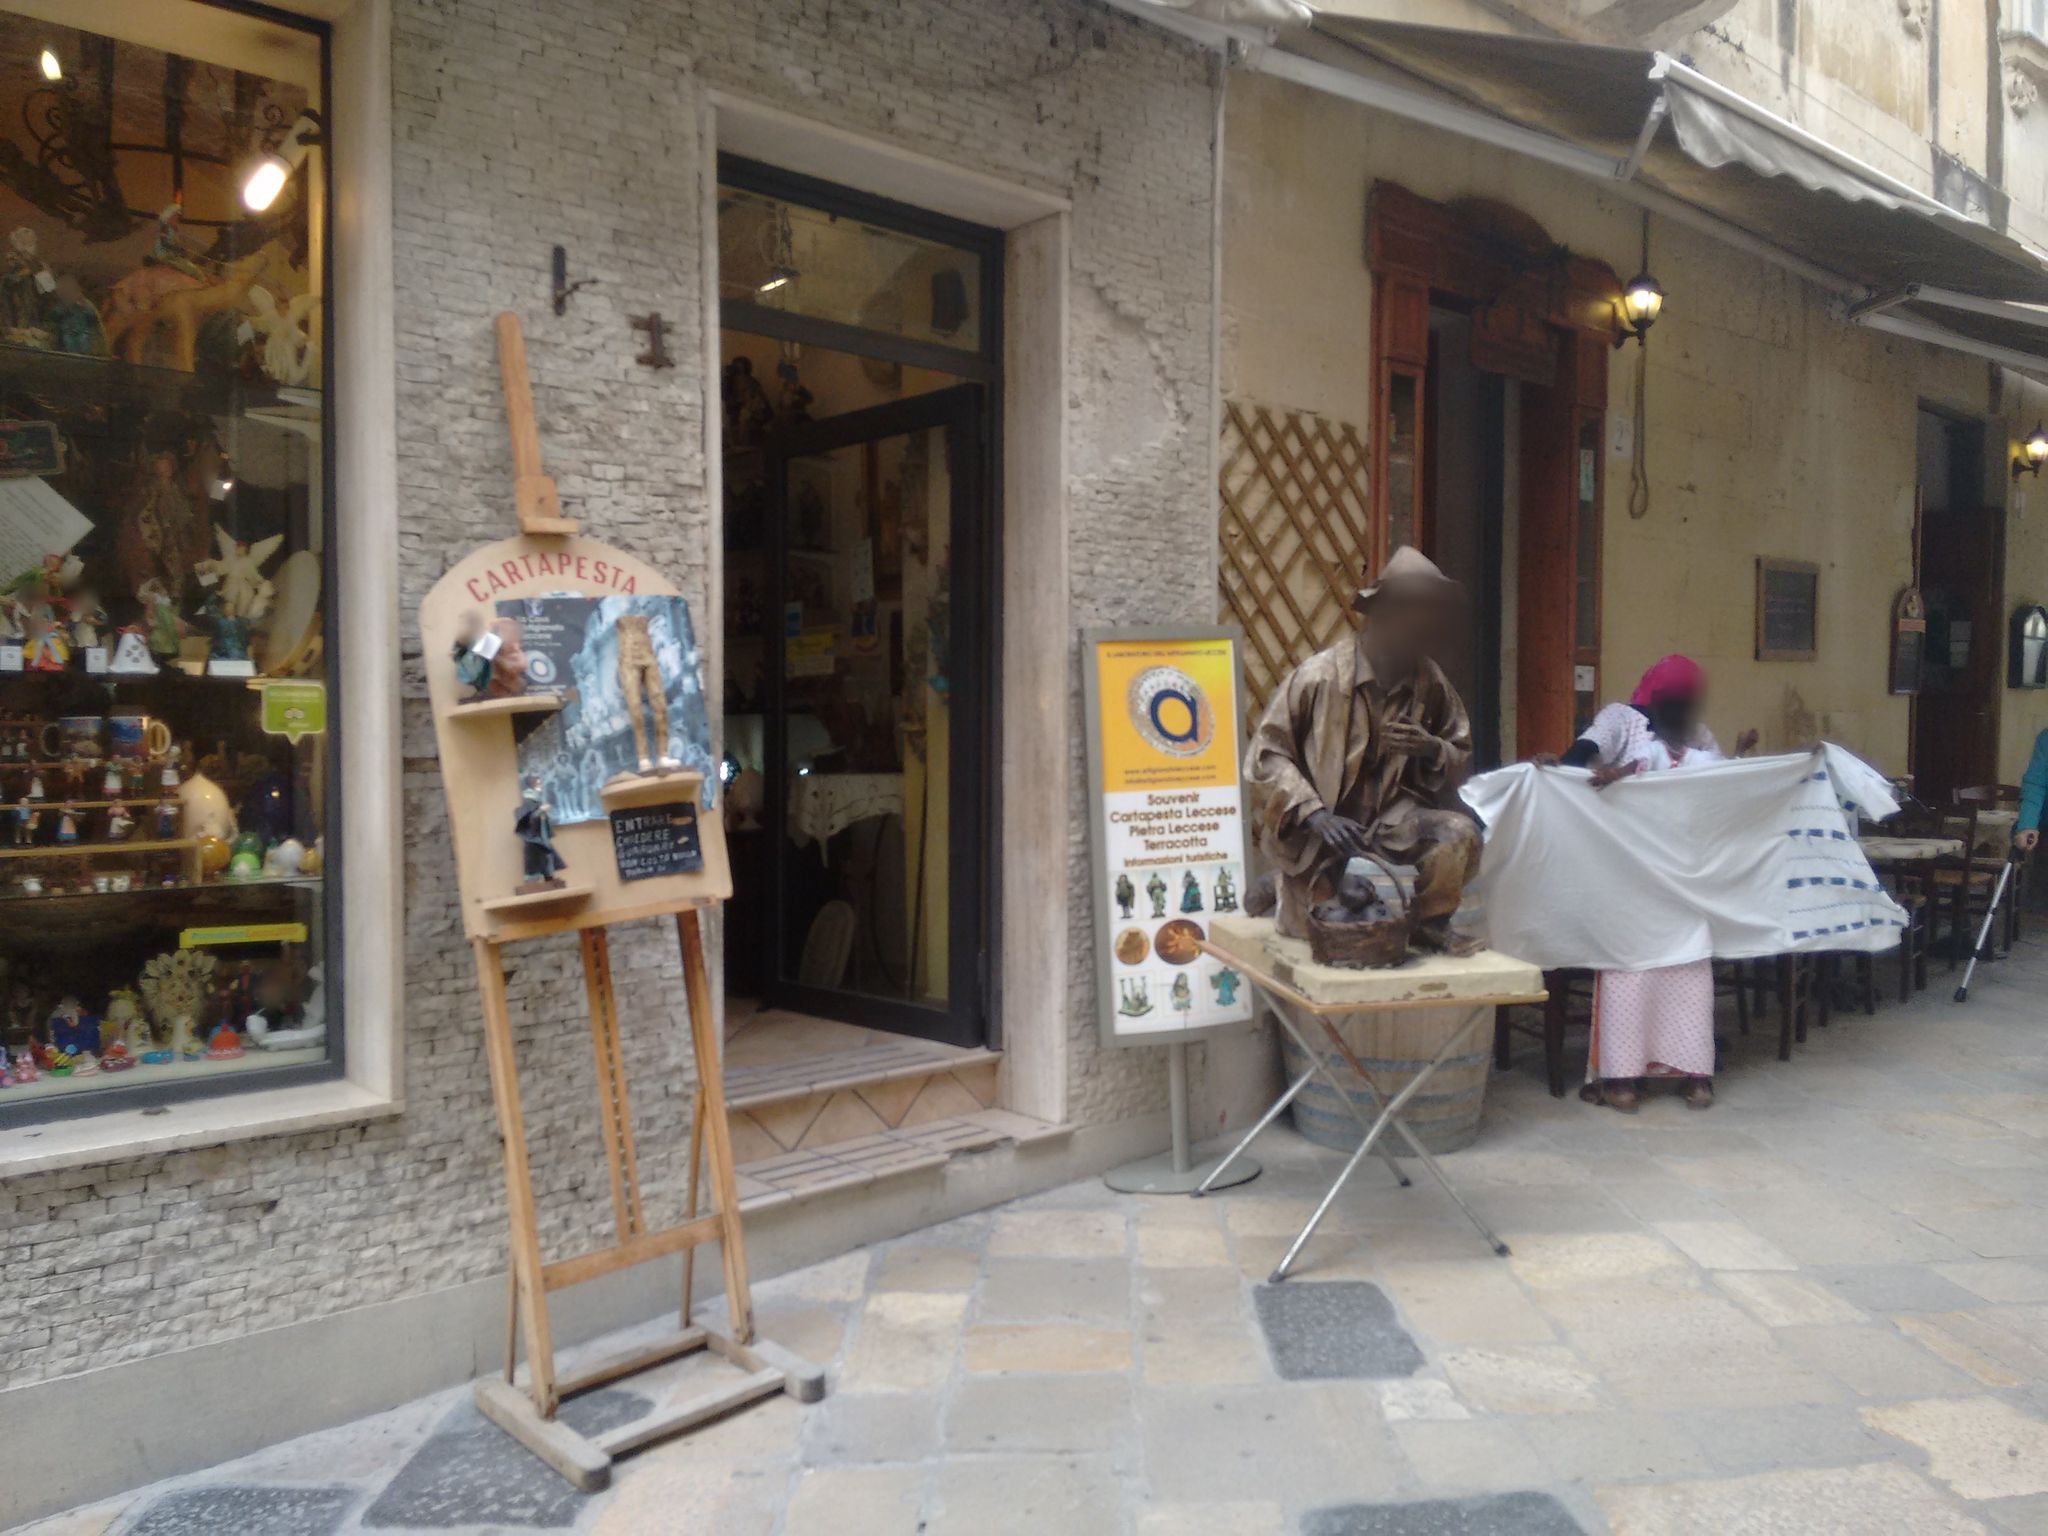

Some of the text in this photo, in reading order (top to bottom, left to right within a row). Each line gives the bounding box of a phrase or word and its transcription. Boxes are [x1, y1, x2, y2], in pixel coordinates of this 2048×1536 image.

[465, 552, 637, 602] CARTAPESTA
[1147, 791, 1200, 806] Souvenir
[1110, 806, 1237, 825] Cartapesta Leccese
[1129, 821, 1220, 837] Pietra Leccese
[1144, 836, 1208, 851] Terracotta
